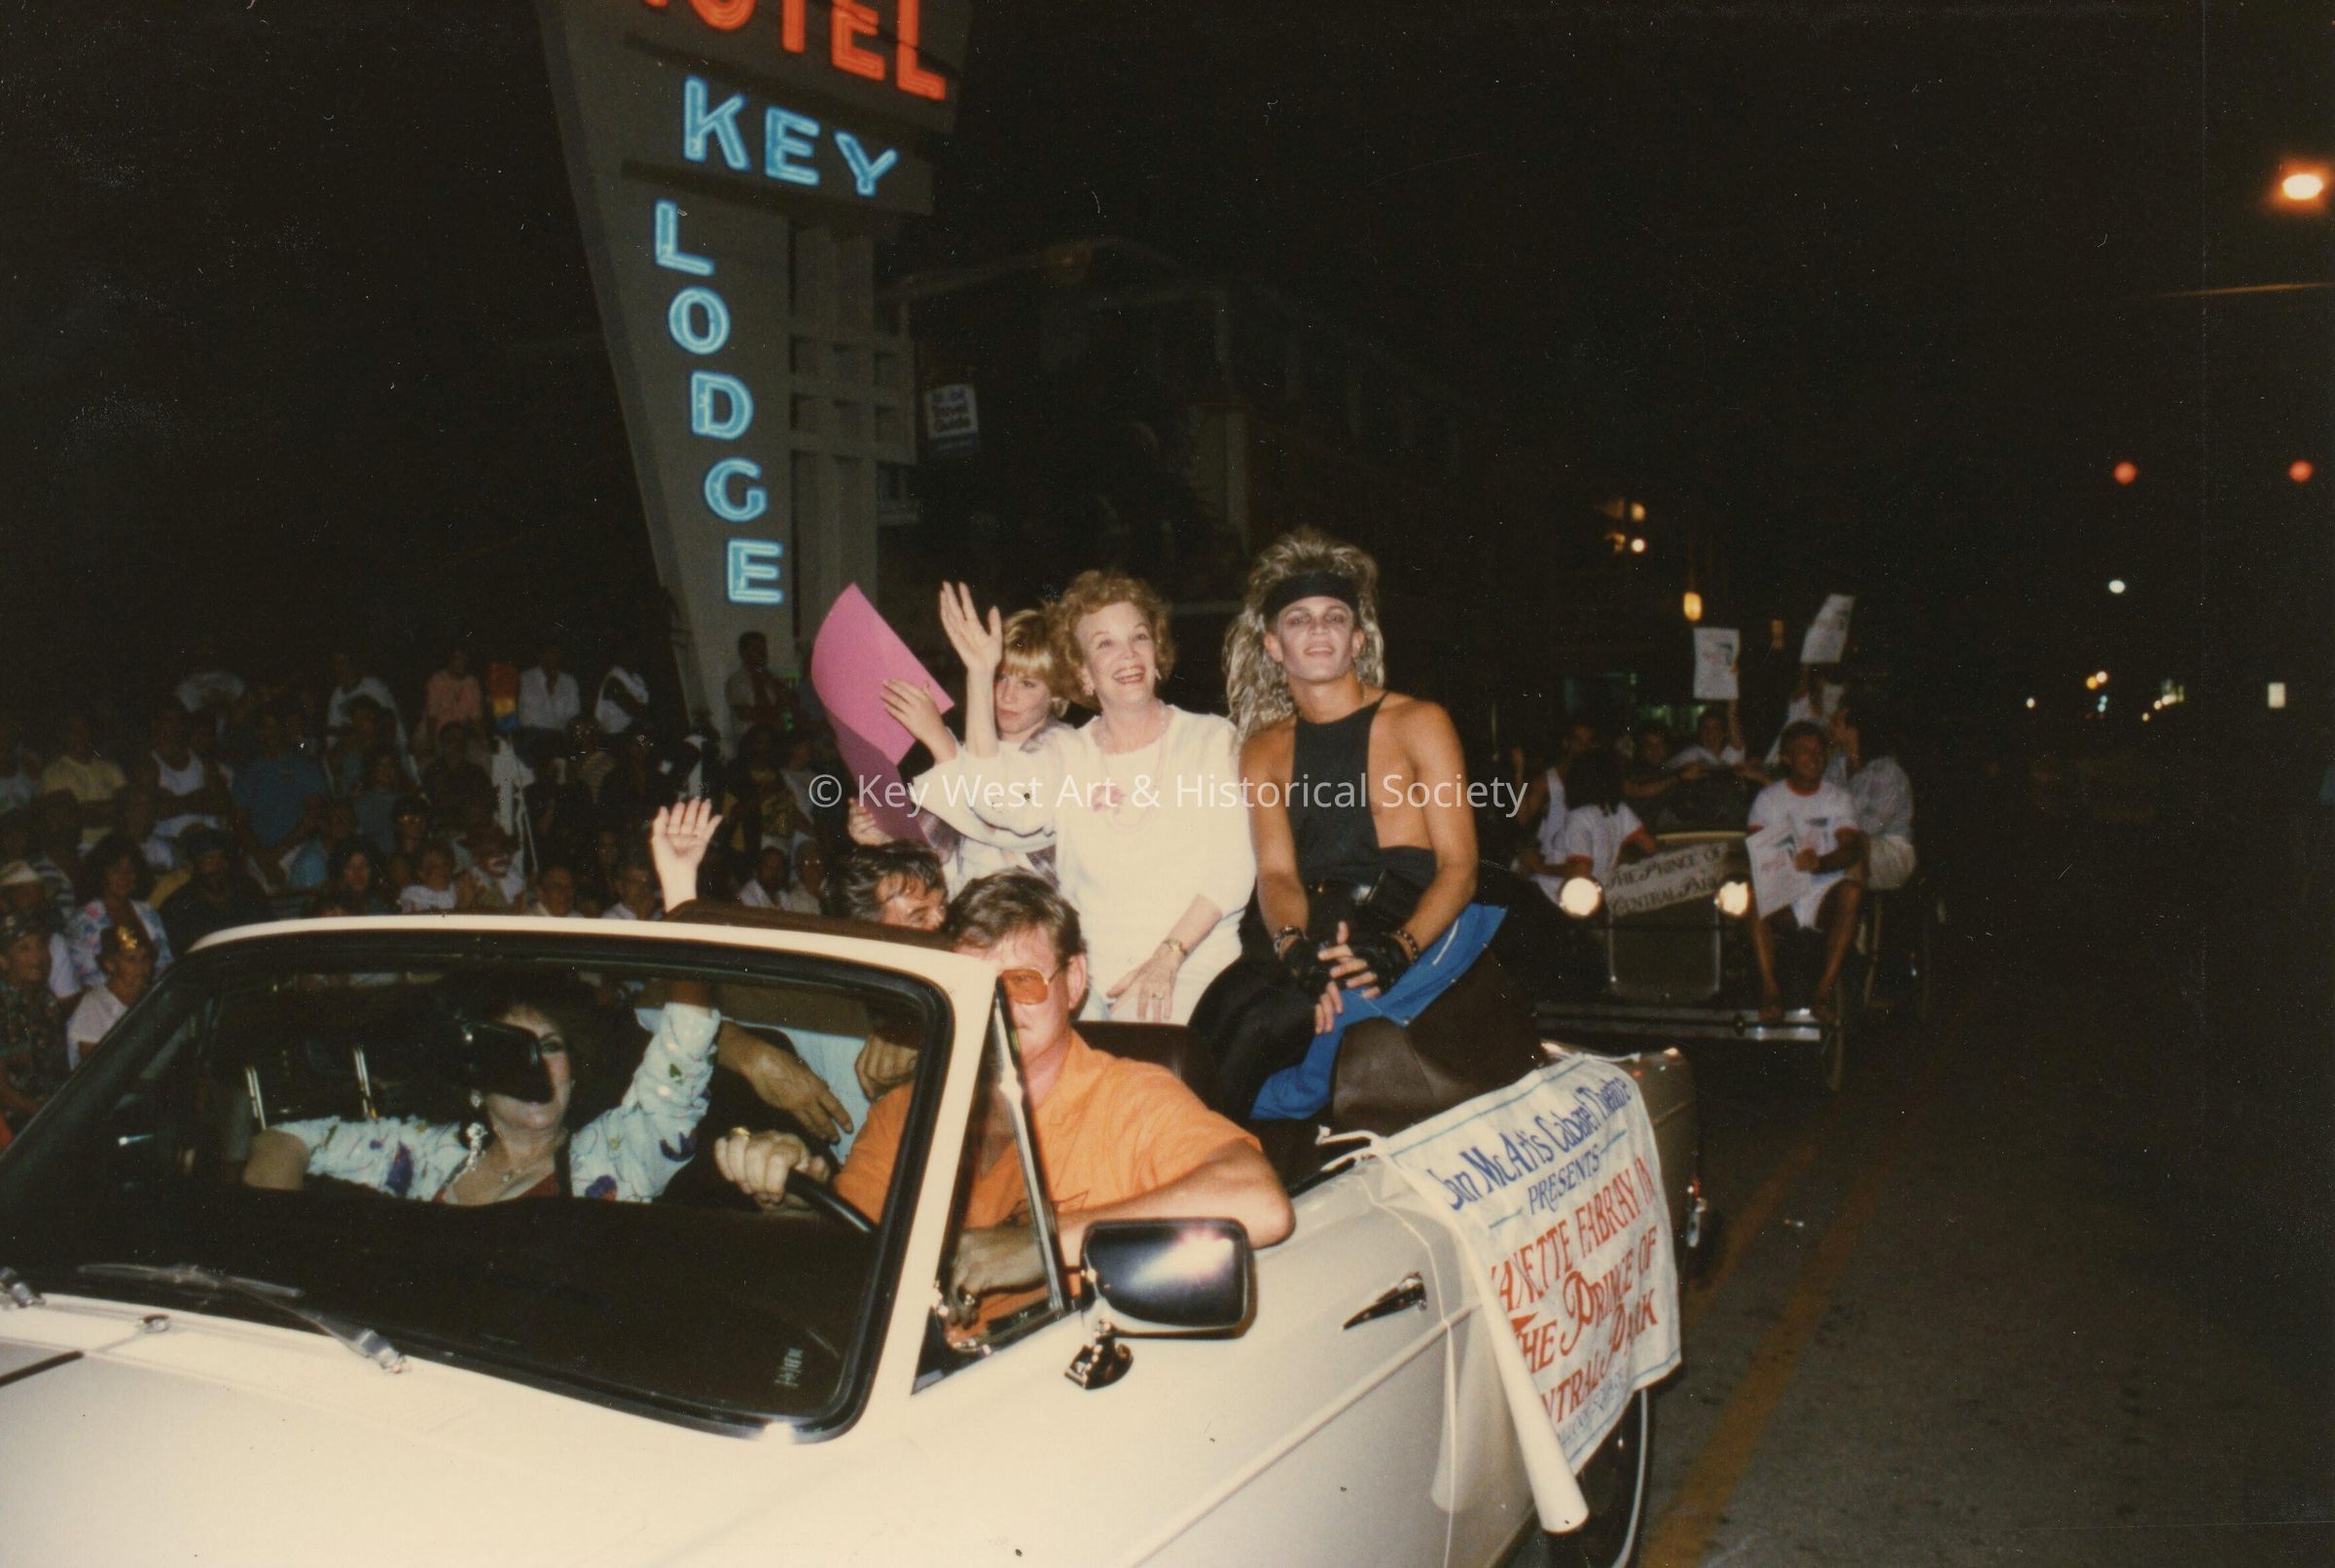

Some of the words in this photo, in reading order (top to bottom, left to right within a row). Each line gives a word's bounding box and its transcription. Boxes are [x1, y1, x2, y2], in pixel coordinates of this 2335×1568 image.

[684, 75, 898, 196] KEY
[654, 198, 783, 604] LODGE
[1426, 1168, 1484, 1211] Jan
[1527, 1143, 1603, 1216] PRESENTS
[1491, 1218, 1573, 1313] ANETTE
[1574, 1167, 1641, 1259] FABRAY
[1637, 1225, 1658, 1277] OF
[1540, 1350, 1599, 1423] NTRAL
